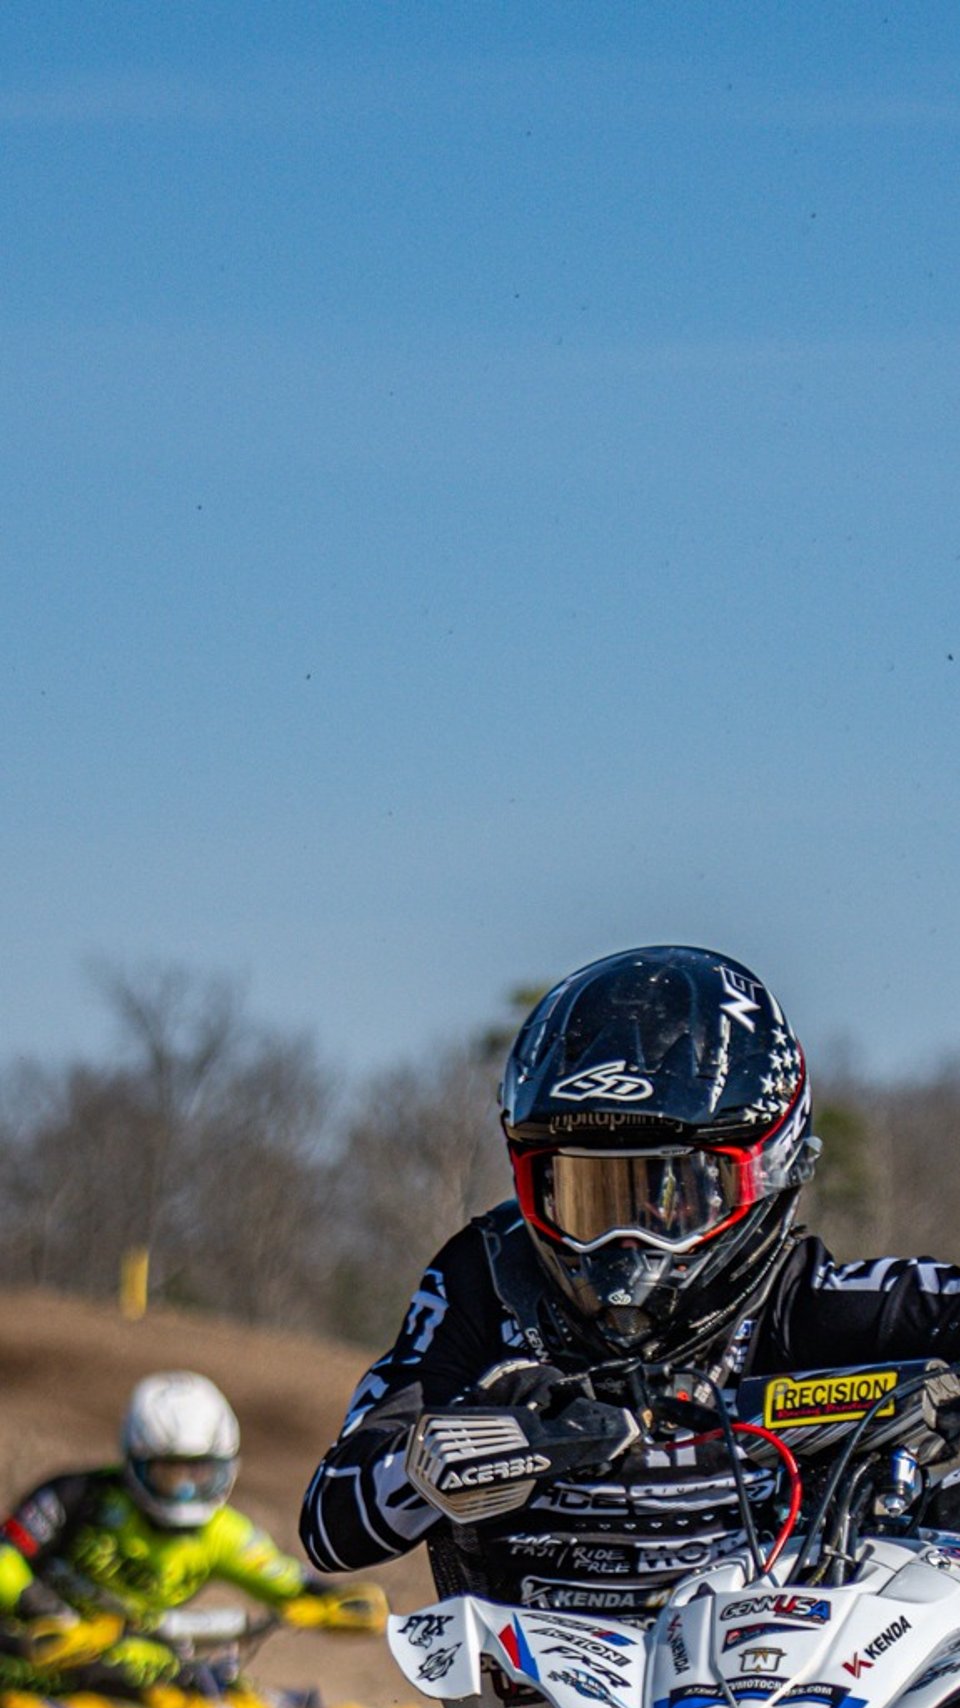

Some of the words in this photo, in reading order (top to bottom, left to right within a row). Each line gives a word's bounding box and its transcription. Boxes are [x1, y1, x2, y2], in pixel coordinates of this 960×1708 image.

[554, 1591, 636, 1608] KENDA
[398, 1614, 454, 1644] FOX
[863, 1615, 913, 1660] KENDA
